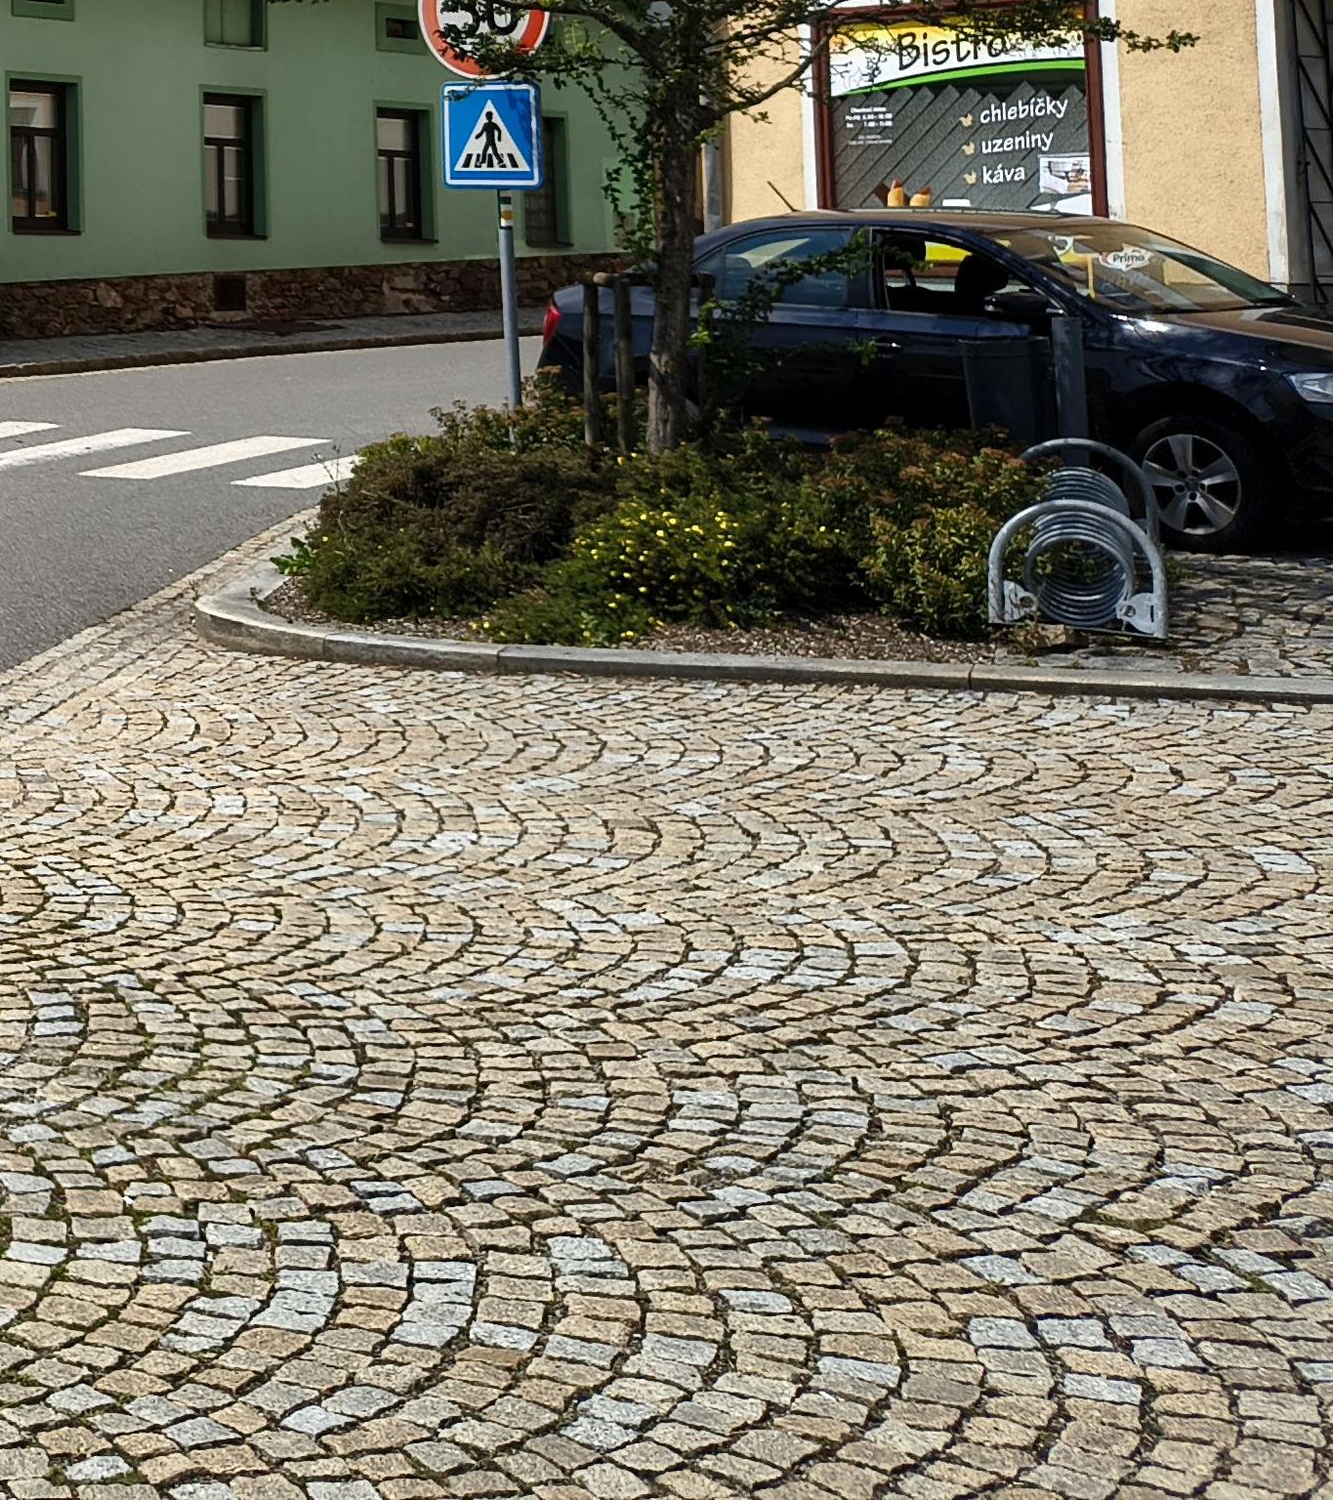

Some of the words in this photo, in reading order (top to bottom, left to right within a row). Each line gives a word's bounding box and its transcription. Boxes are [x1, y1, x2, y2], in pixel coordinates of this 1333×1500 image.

[896, 31, 1007, 70] Bistro
[980, 96, 1068, 124] chlebíčky
[981, 130, 1053, 154] uzeniny
[982, 163, 1026, 184] káva
